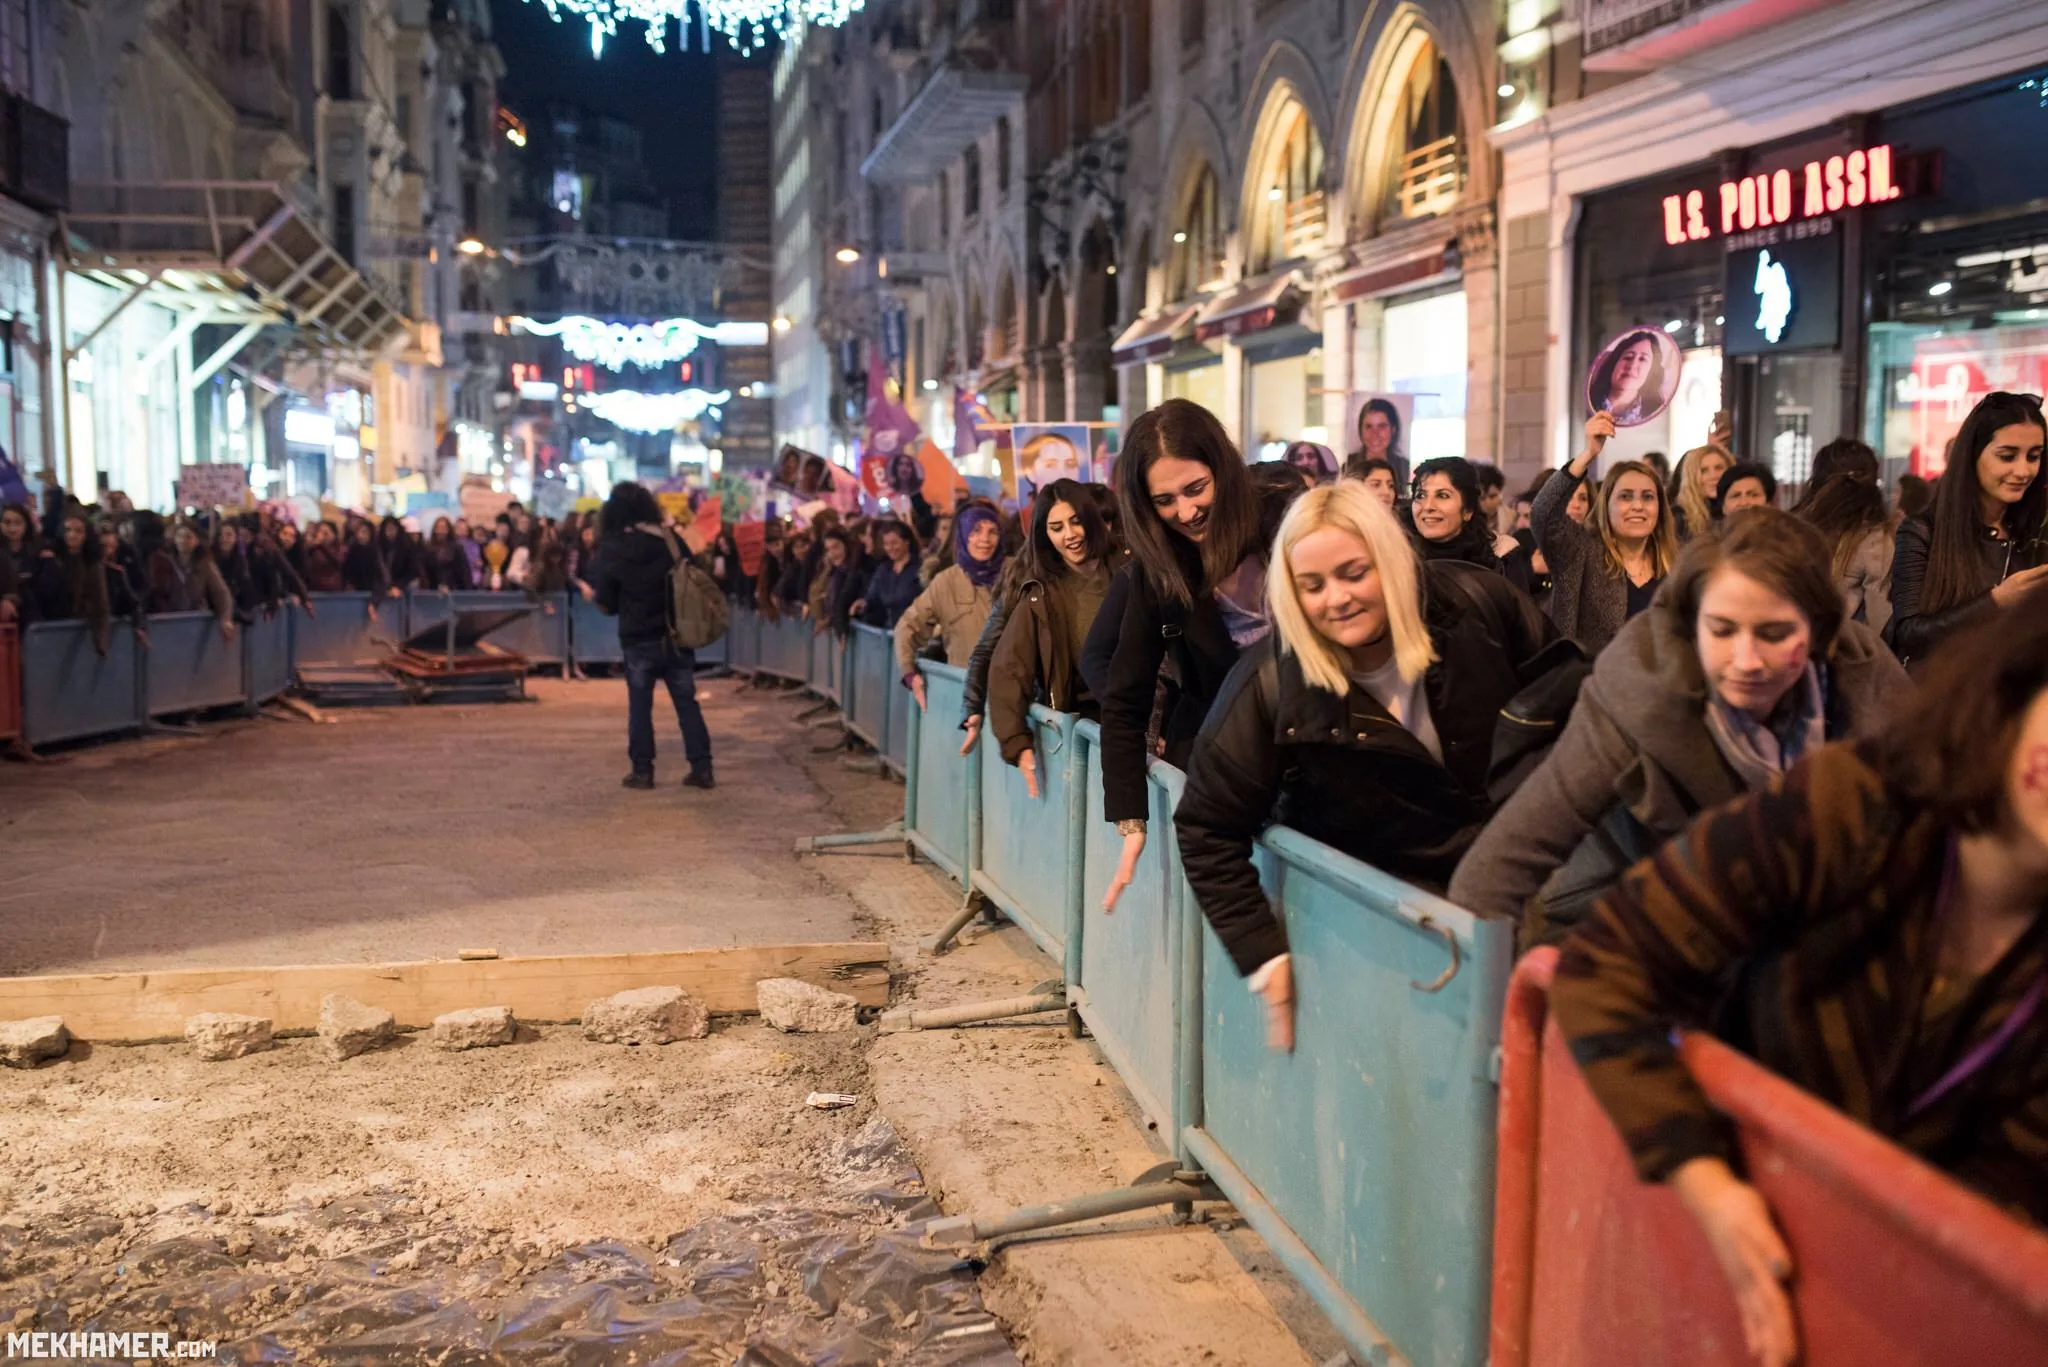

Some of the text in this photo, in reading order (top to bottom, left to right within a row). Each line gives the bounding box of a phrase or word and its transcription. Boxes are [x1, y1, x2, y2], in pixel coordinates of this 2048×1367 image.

[1662, 143, 1901, 246] U.S. POLO ASSN.
[1725, 216, 1833, 253] SINCE 1890
